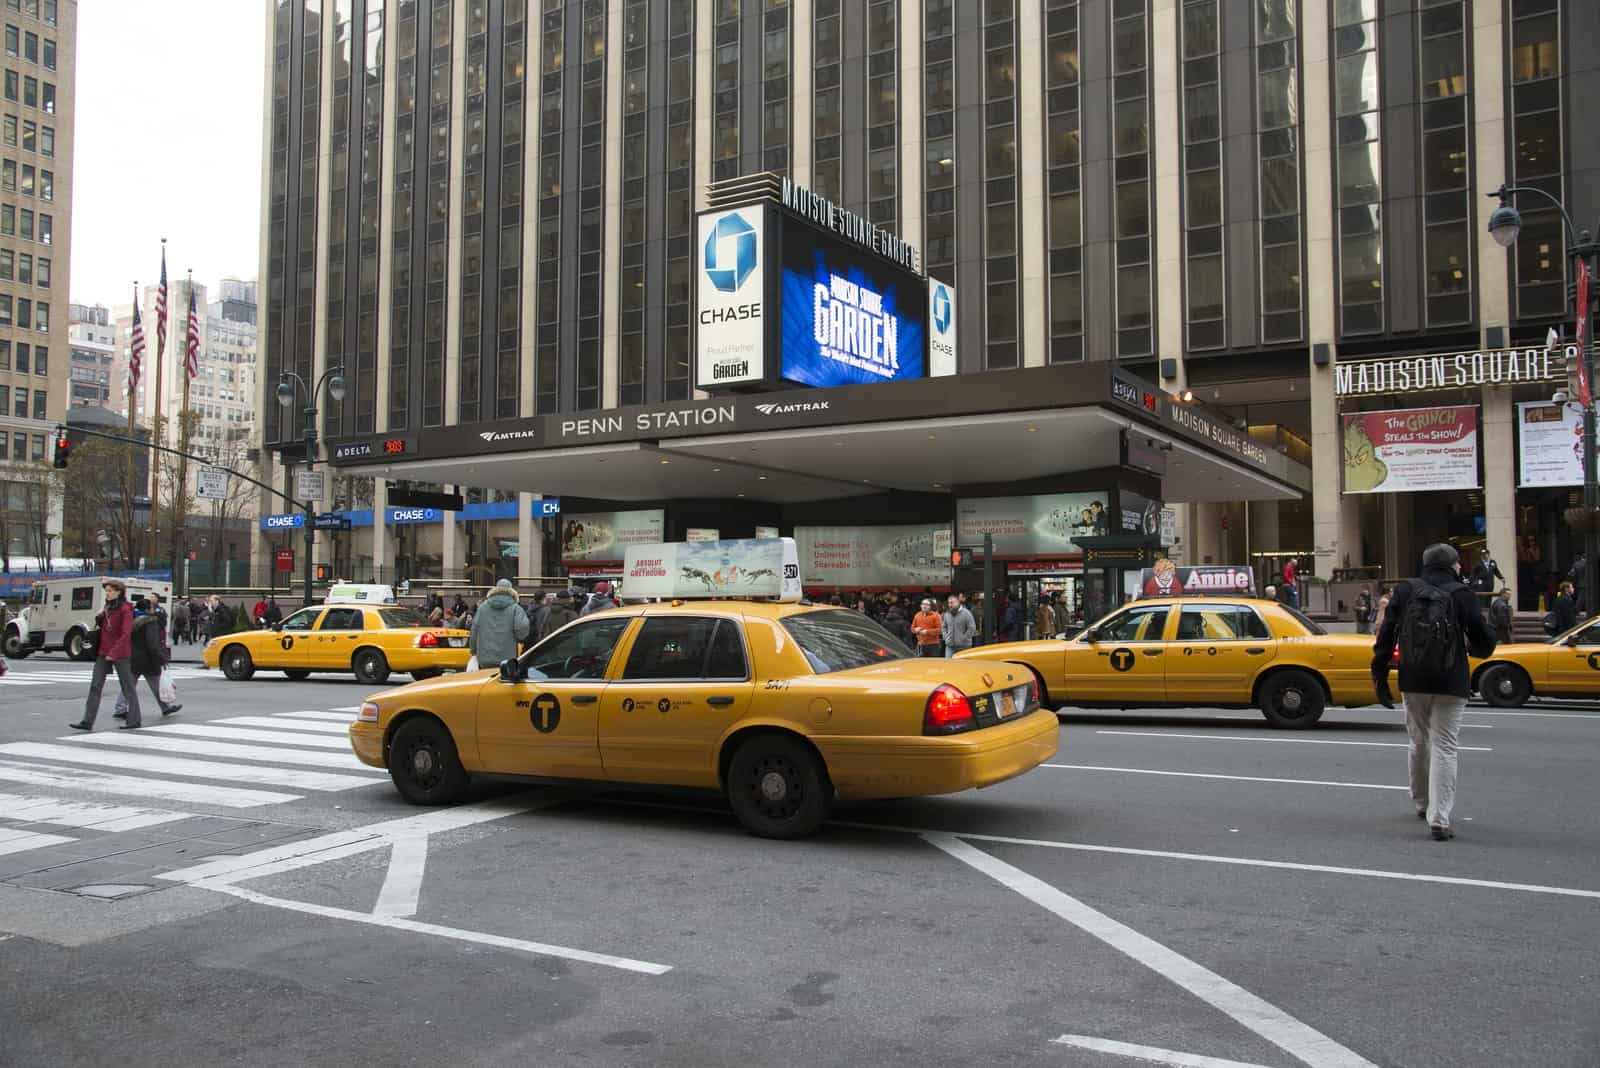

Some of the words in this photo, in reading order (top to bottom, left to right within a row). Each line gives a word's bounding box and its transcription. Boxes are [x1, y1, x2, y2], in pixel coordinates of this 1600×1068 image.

[782, 176, 834, 228] MADISON
[839, 207, 876, 251] SQUARE
[700, 303, 761, 324] CHASE
[814, 282, 898, 370] GARDEN
[1336, 357, 1445, 394] MADISON
[1455, 348, 1553, 386] SQUARE
[774, 401, 830, 415] AMTRAK
[562, 416, 623, 437] PENN
[636, 406, 736, 431] STATION
[1385, 417, 1406, 430] The
[1407, 409, 1457, 432] GRINCH
[494, 429, 535, 442] AMTRAK
[1172, 406, 1211, 437] MADISON
[1212, 425, 1241, 452] SQUARE
[1242, 441, 1267, 465] GARDEN
[1384, 433, 1414, 442] STEALS
[344, 445, 371, 457] DELTA
[268, 516, 294, 527] CHASE
[394, 508, 424, 520] CHASE
[1184, 569, 1249, 590] Annie
[537, 701, 554, 729] T
